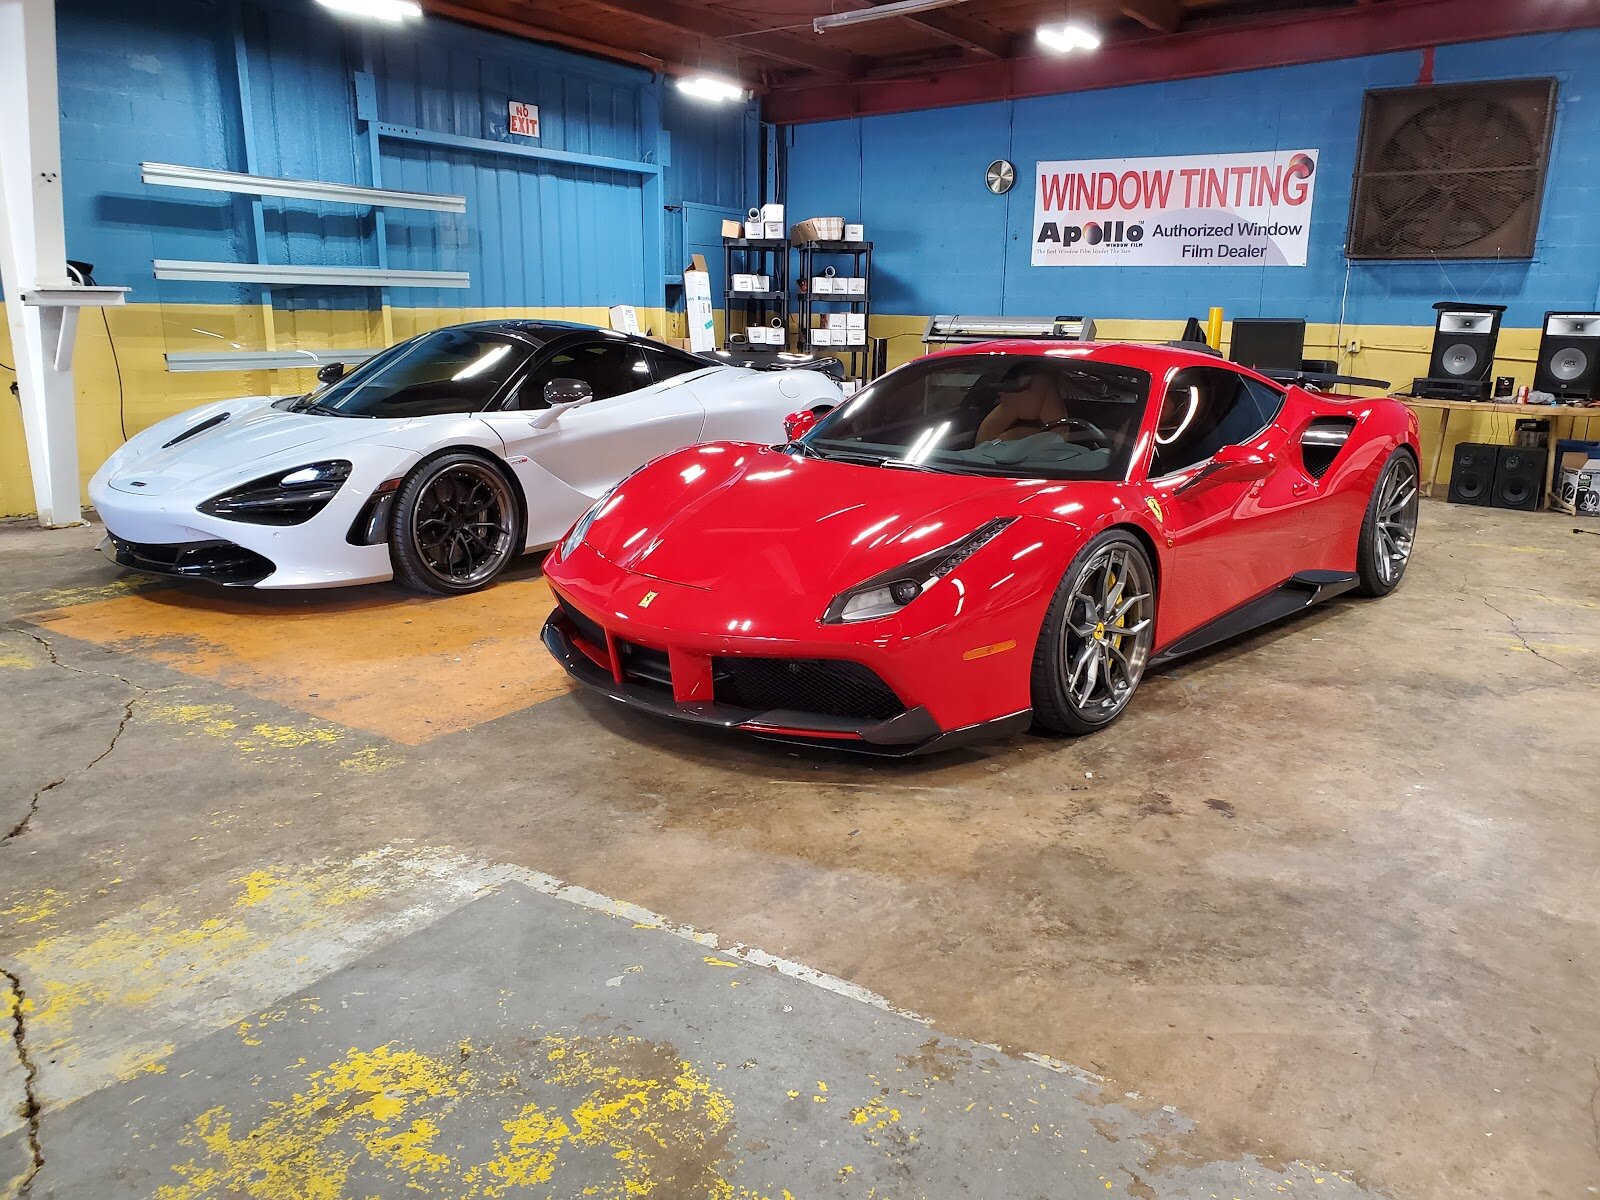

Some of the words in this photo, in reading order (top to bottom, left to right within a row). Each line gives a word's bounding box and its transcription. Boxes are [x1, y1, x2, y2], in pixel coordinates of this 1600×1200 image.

[515, 106, 529, 117] NO
[511, 115, 537, 135] EXIT
[1041, 169, 1174, 212] WINDOW
[1179, 163, 1309, 209] TINTING
[1037, 221, 1144, 247] Apollo
[1152, 223, 1234, 238] Authorized
[1237, 222, 1303, 237] Window
[1182, 244, 1213, 258] Film
[1217, 243, 1267, 258] Dealer
